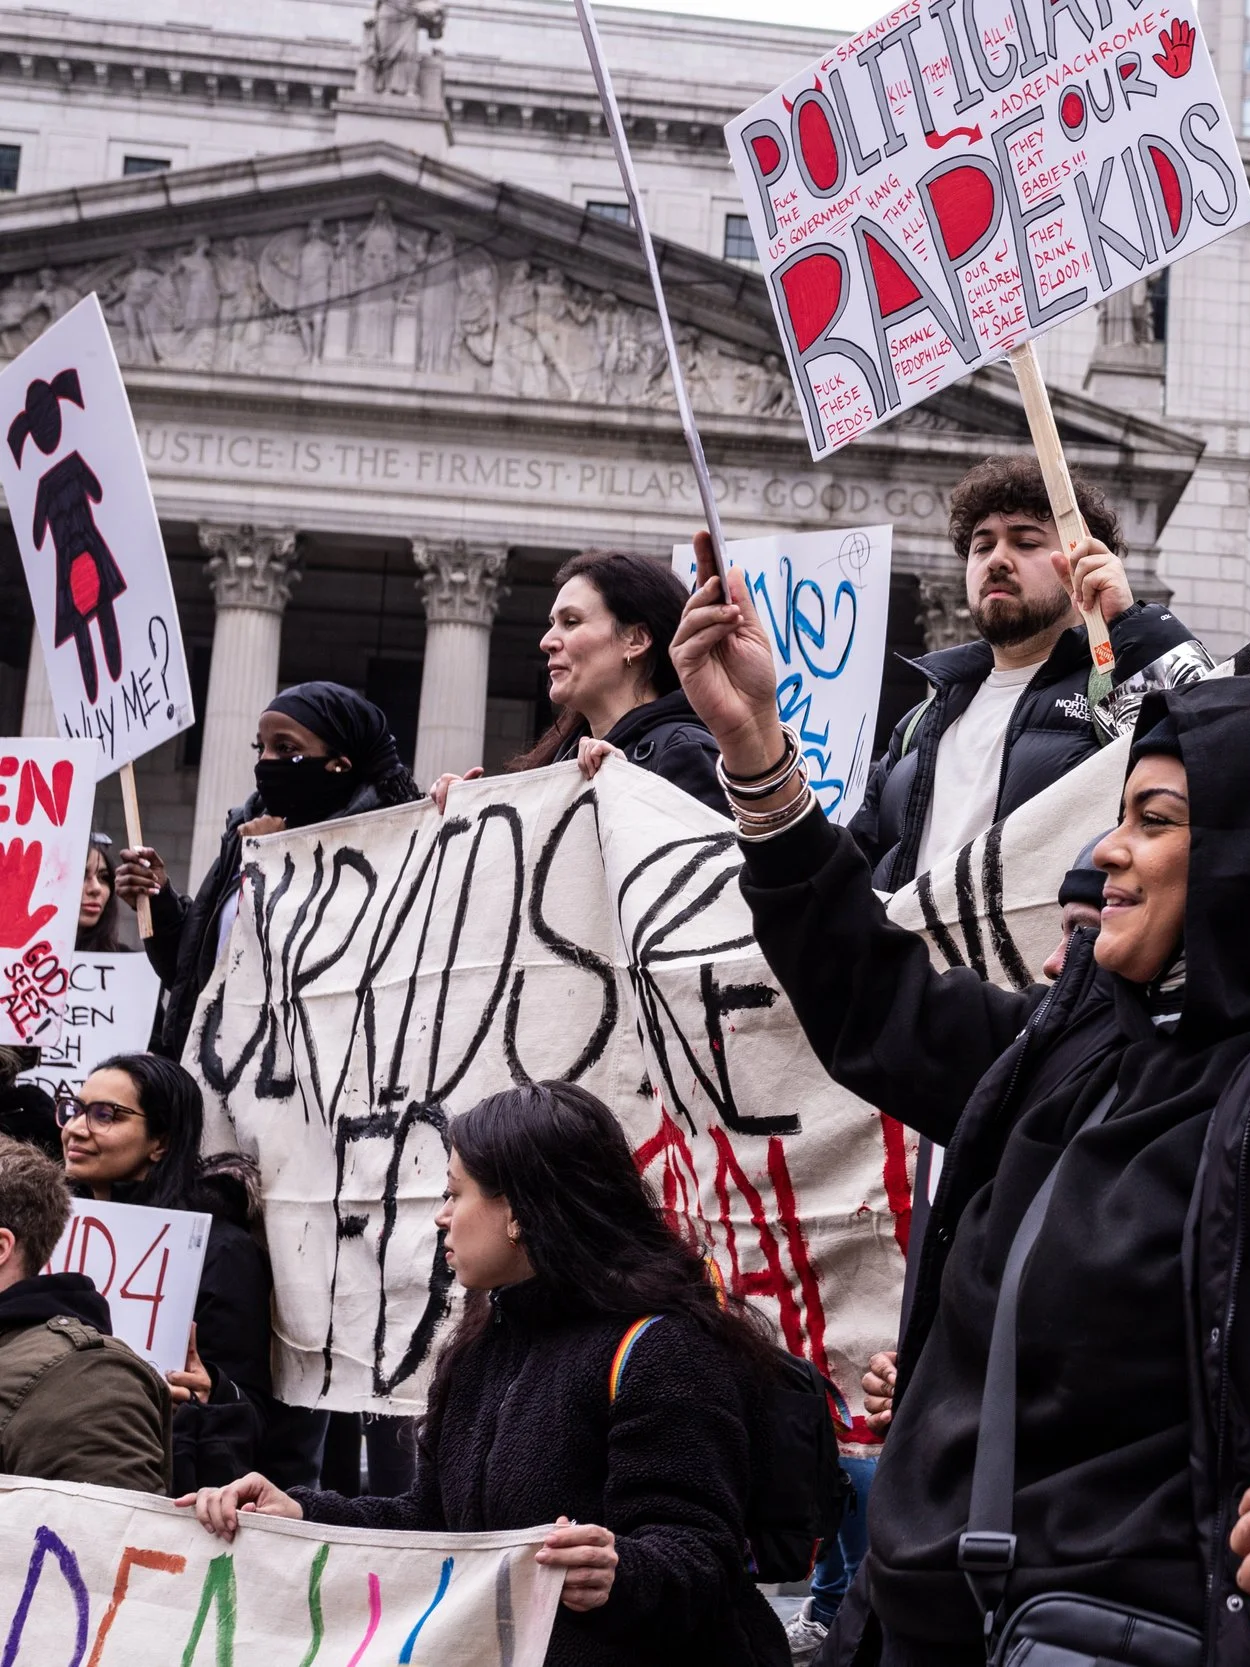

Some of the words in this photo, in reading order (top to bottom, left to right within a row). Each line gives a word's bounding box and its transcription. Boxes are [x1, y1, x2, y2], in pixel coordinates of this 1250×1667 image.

[836, 0, 921, 62] SATANISTS
[886, 80, 912, 106] KILL
[922, 56, 953, 84] THEM
[983, 14, 1015, 49] ALL!!
[1001, 12, 1158, 119] ADRENACHROME
[1059, 52, 1157, 142] OUR
[1009, 127, 1045, 157] THEY
[1017, 149, 1044, 176] EAT
[1022, 150, 1088, 199] BABIES!!!
[773, 188, 799, 212] FUCK
[865, 173, 901, 210] HANG
[883, 187, 916, 224] THEM
[769, 237, 787, 260] US
[790, 185, 862, 244] GOVERNMENT
[777, 207, 801, 229] THE
[902, 208, 929, 243] ALL!
[1029, 218, 1064, 248] THEY
[1034, 237, 1076, 269] DRINK
[770, 105, 1088, 451] RAPE
[1074, 103, 1237, 292] KIDS
[964, 261, 990, 283] OUR
[968, 265, 1020, 304] CHILDREN
[1039, 252, 1093, 297] BLOOD!!
[972, 300, 996, 322] ARE
[999, 283, 1023, 305] NOT
[890, 323, 937, 358] SATANIC
[979, 323, 989, 340] 4
[992, 305, 1026, 337] SALE
[894, 336, 954, 380] PEDOPHILES
[813, 373, 846, 400] FUCK
[819, 385, 861, 420] THESE
[826, 405, 874, 442] PEDO'S
[290, 441, 322, 474] IS
[333, 443, 401, 480] THE
[416, 449, 566, 493] FIRMEST
[579, 465, 688, 502] PILLAR
[707, 472, 748, 504] OF
[763, 477, 871, 516] GOOD
[121, 615, 175, 732] ME?
[1073, 692, 1088, 705] TH
[22, 940, 69, 997] GOD
[4, 962, 50, 1019] SEES
